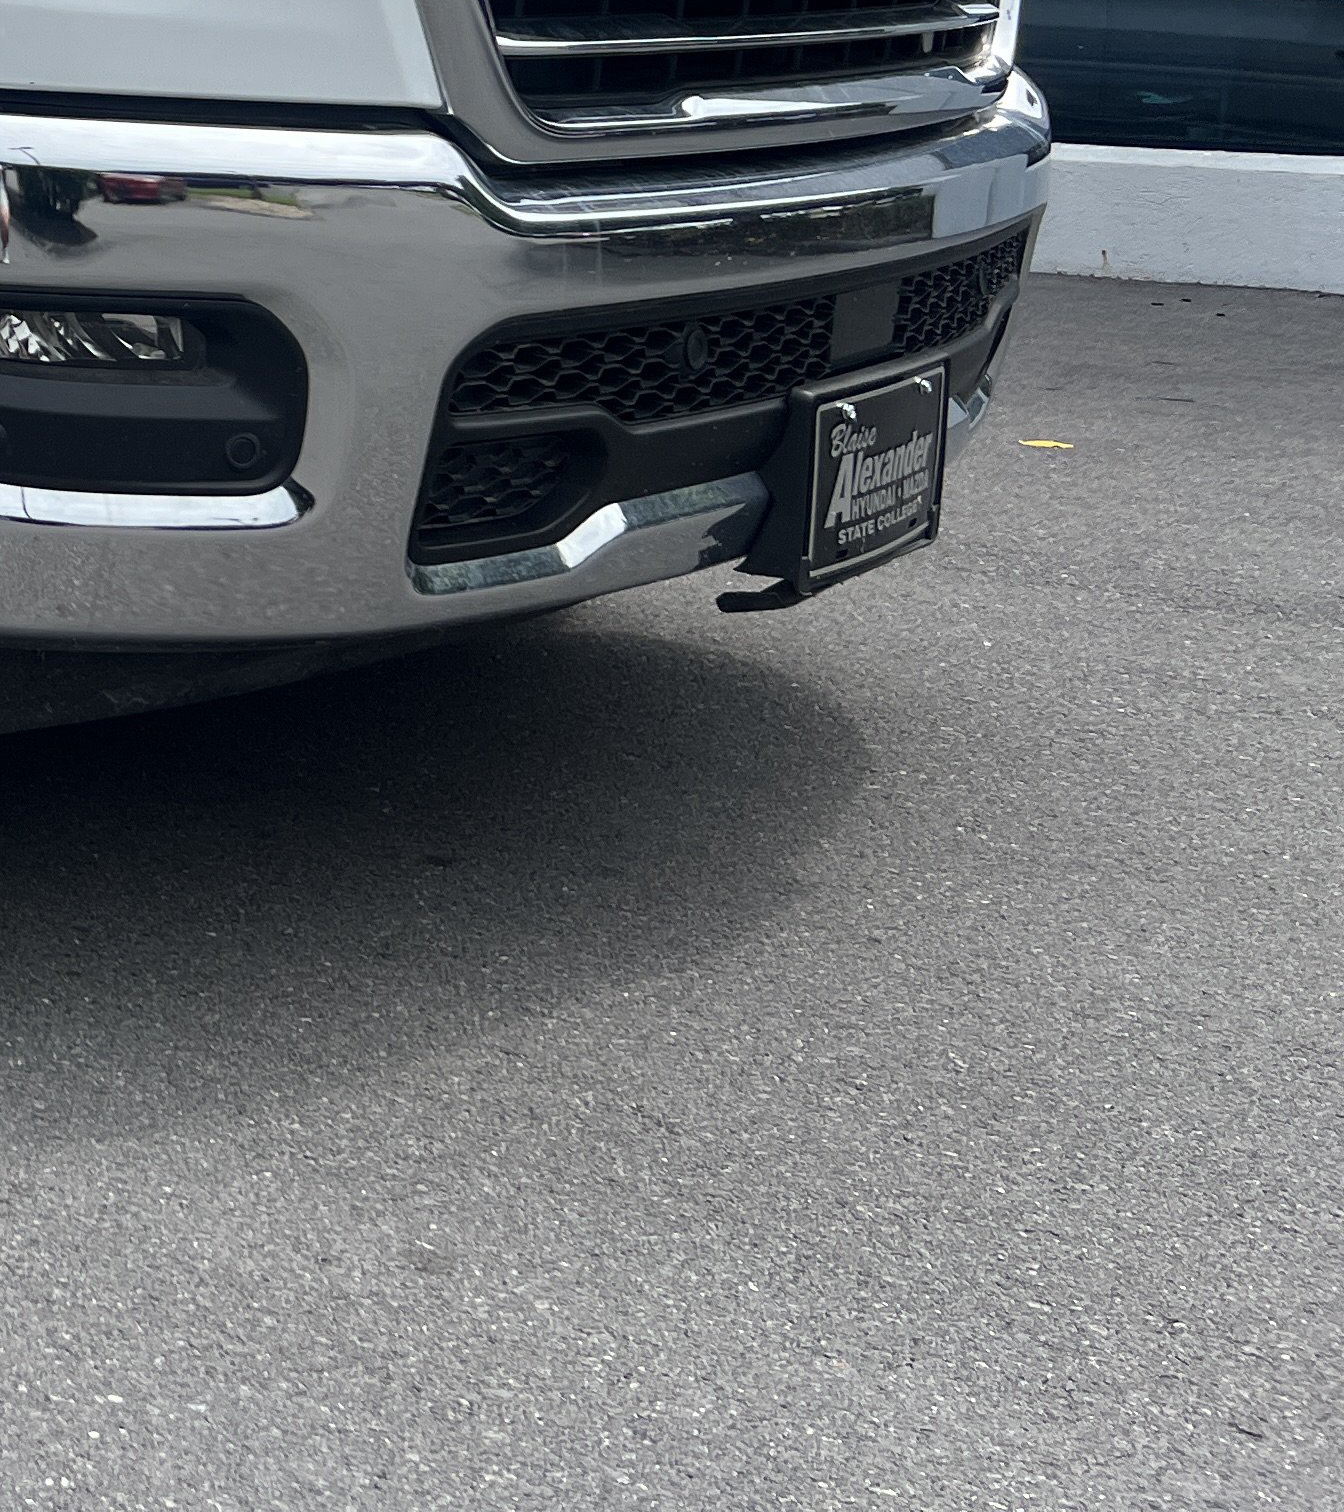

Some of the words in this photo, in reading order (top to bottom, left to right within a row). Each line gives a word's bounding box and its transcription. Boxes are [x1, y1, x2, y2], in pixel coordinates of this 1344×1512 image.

[830, 423, 877, 458] Blaise
[823, 430, 934, 529] Alexander
[852, 484, 896, 520] HYUNDAI
[837, 519, 875, 545] STATE
